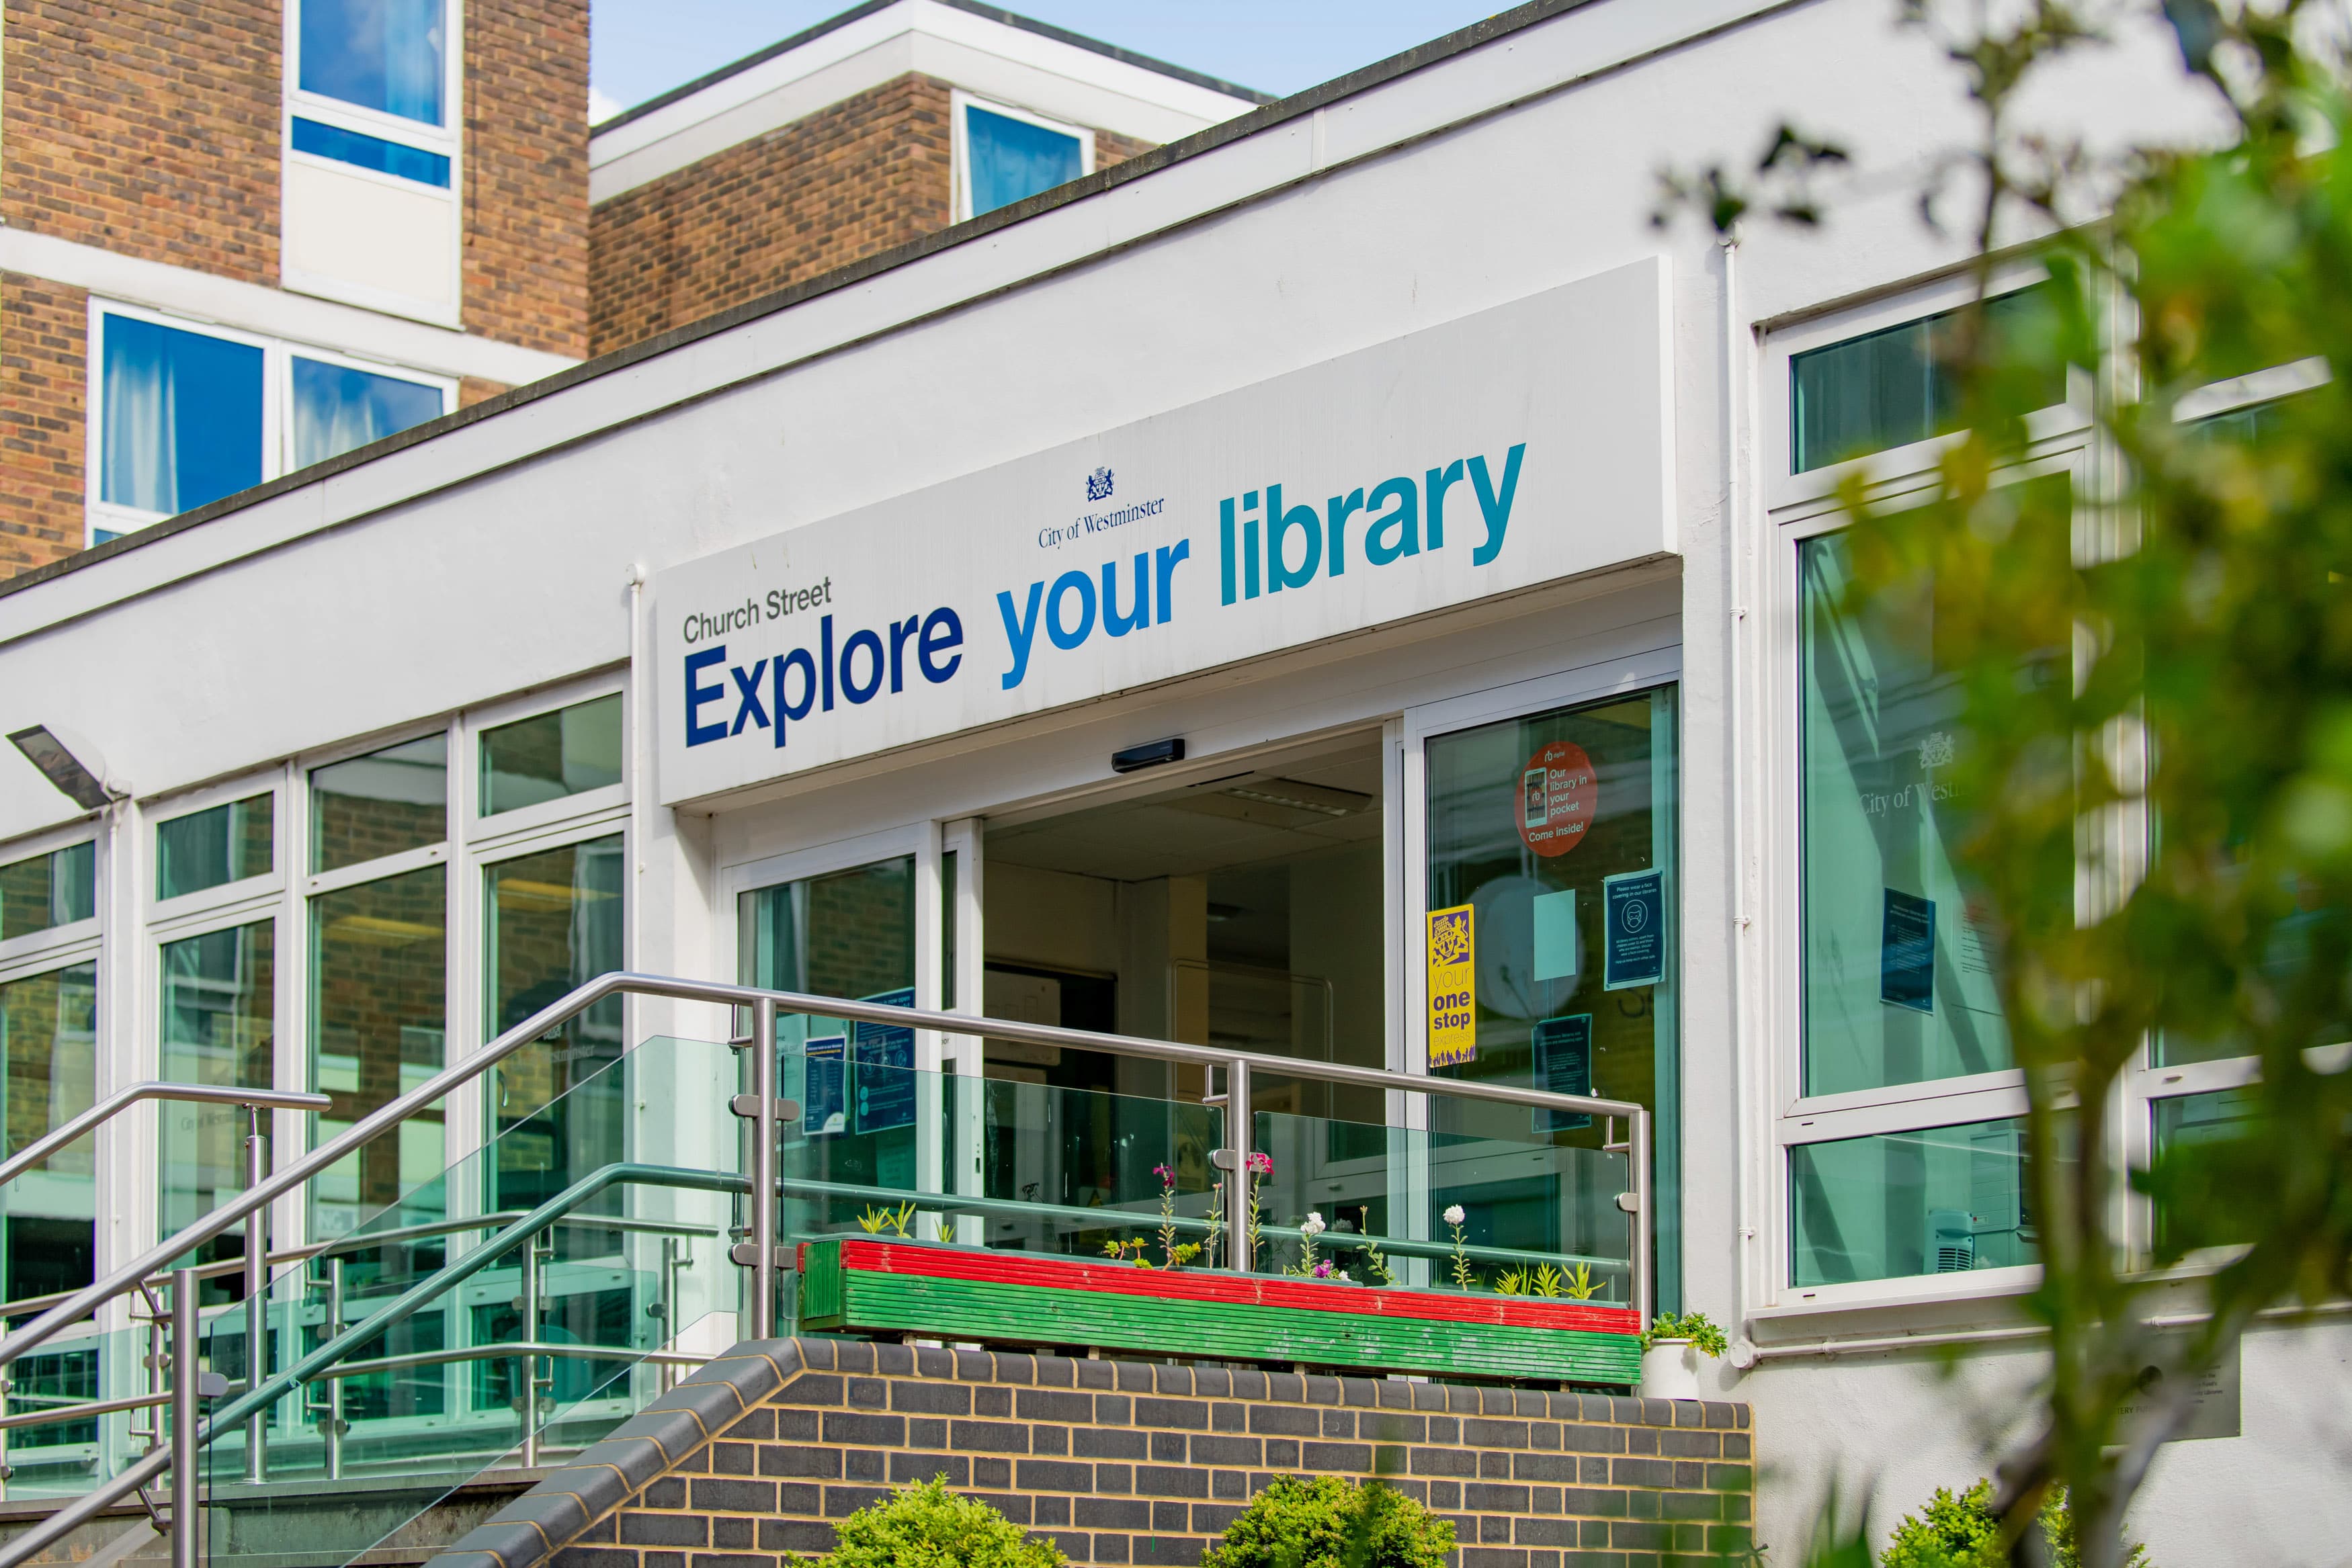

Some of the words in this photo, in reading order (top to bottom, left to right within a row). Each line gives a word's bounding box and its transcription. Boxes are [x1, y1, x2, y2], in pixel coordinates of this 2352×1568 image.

[1038, 527, 1065, 549] City
[1066, 521, 1080, 541] of
[1083, 498, 1165, 535] Westminster
[684, 607, 964, 749] Explore
[996, 538, 1189, 691] your
[1220, 442, 1527, 607] library
[683, 598, 759, 644] Church
[766, 576, 832, 620] Street
[1550, 769, 1566, 779] Our
[1550, 779, 1577, 791] library
[1579, 775, 1587, 785] in
[1550, 791, 1569, 806] your
[1859, 793, 1890, 818] City
[1893, 784, 1911, 808] of
[1550, 801, 1579, 818] pocket
[1529, 830, 1554, 842] Come
[1556, 821, 1584, 836] inside!
[1433, 967, 1470, 996] your
[1433, 991, 1470, 1012] one
[1433, 1012, 1470, 1030] stop
[1433, 1031, 1471, 1048] express
